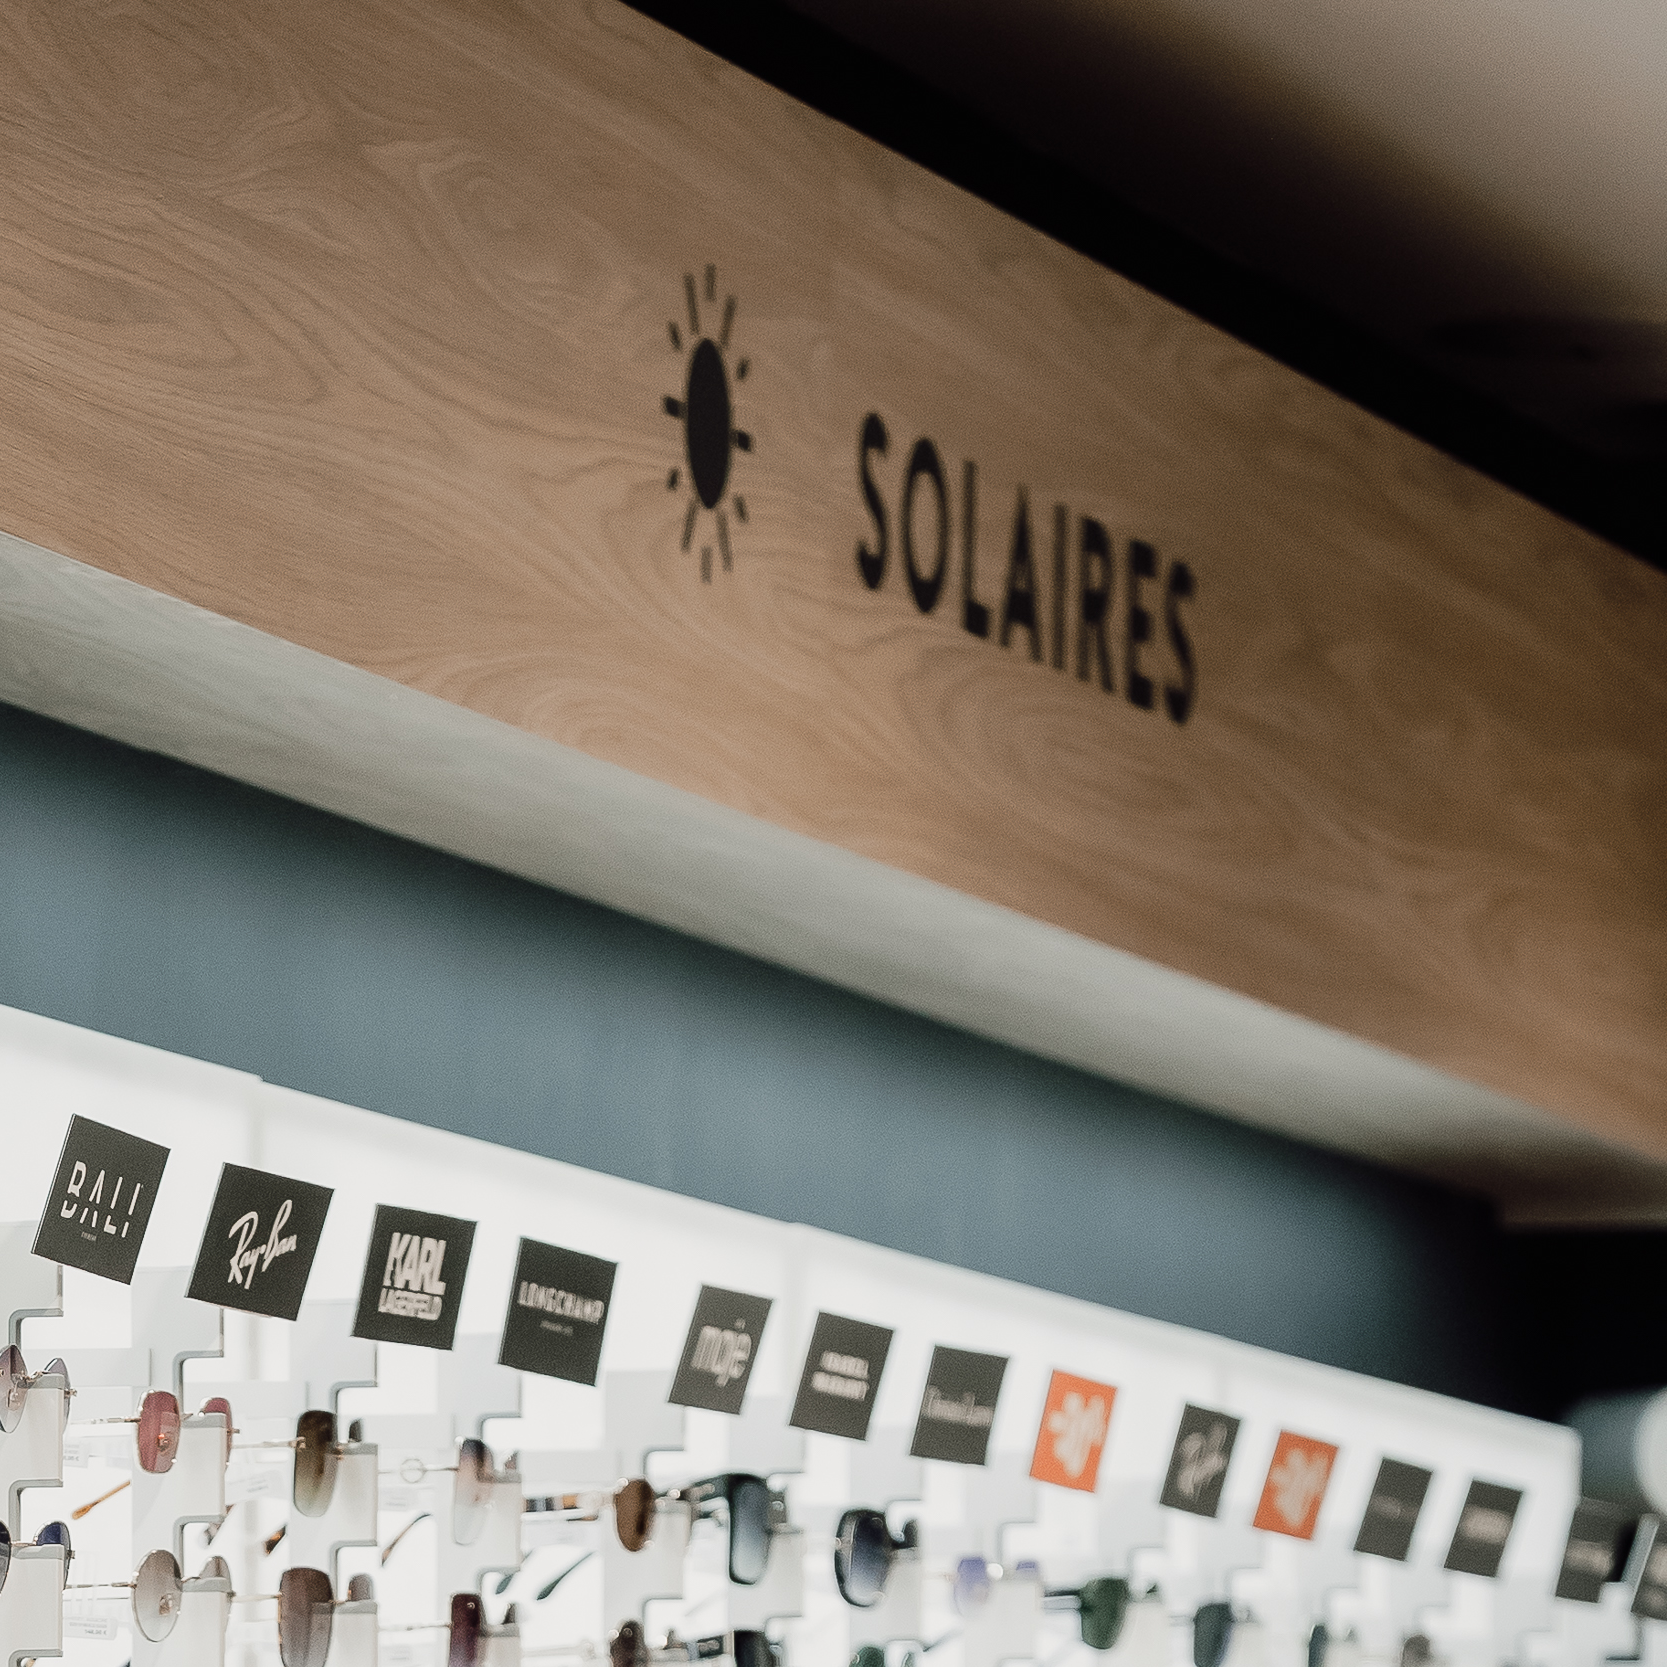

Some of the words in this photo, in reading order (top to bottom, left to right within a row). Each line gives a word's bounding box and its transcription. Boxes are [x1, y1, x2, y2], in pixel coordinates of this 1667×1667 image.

[854, 411, 1199, 726] SOLAIRES
[60, 1160, 143, 1238] BALI
[227, 1199, 298, 1290] Ray-Ban
[382, 1231, 447, 1296] KARL
